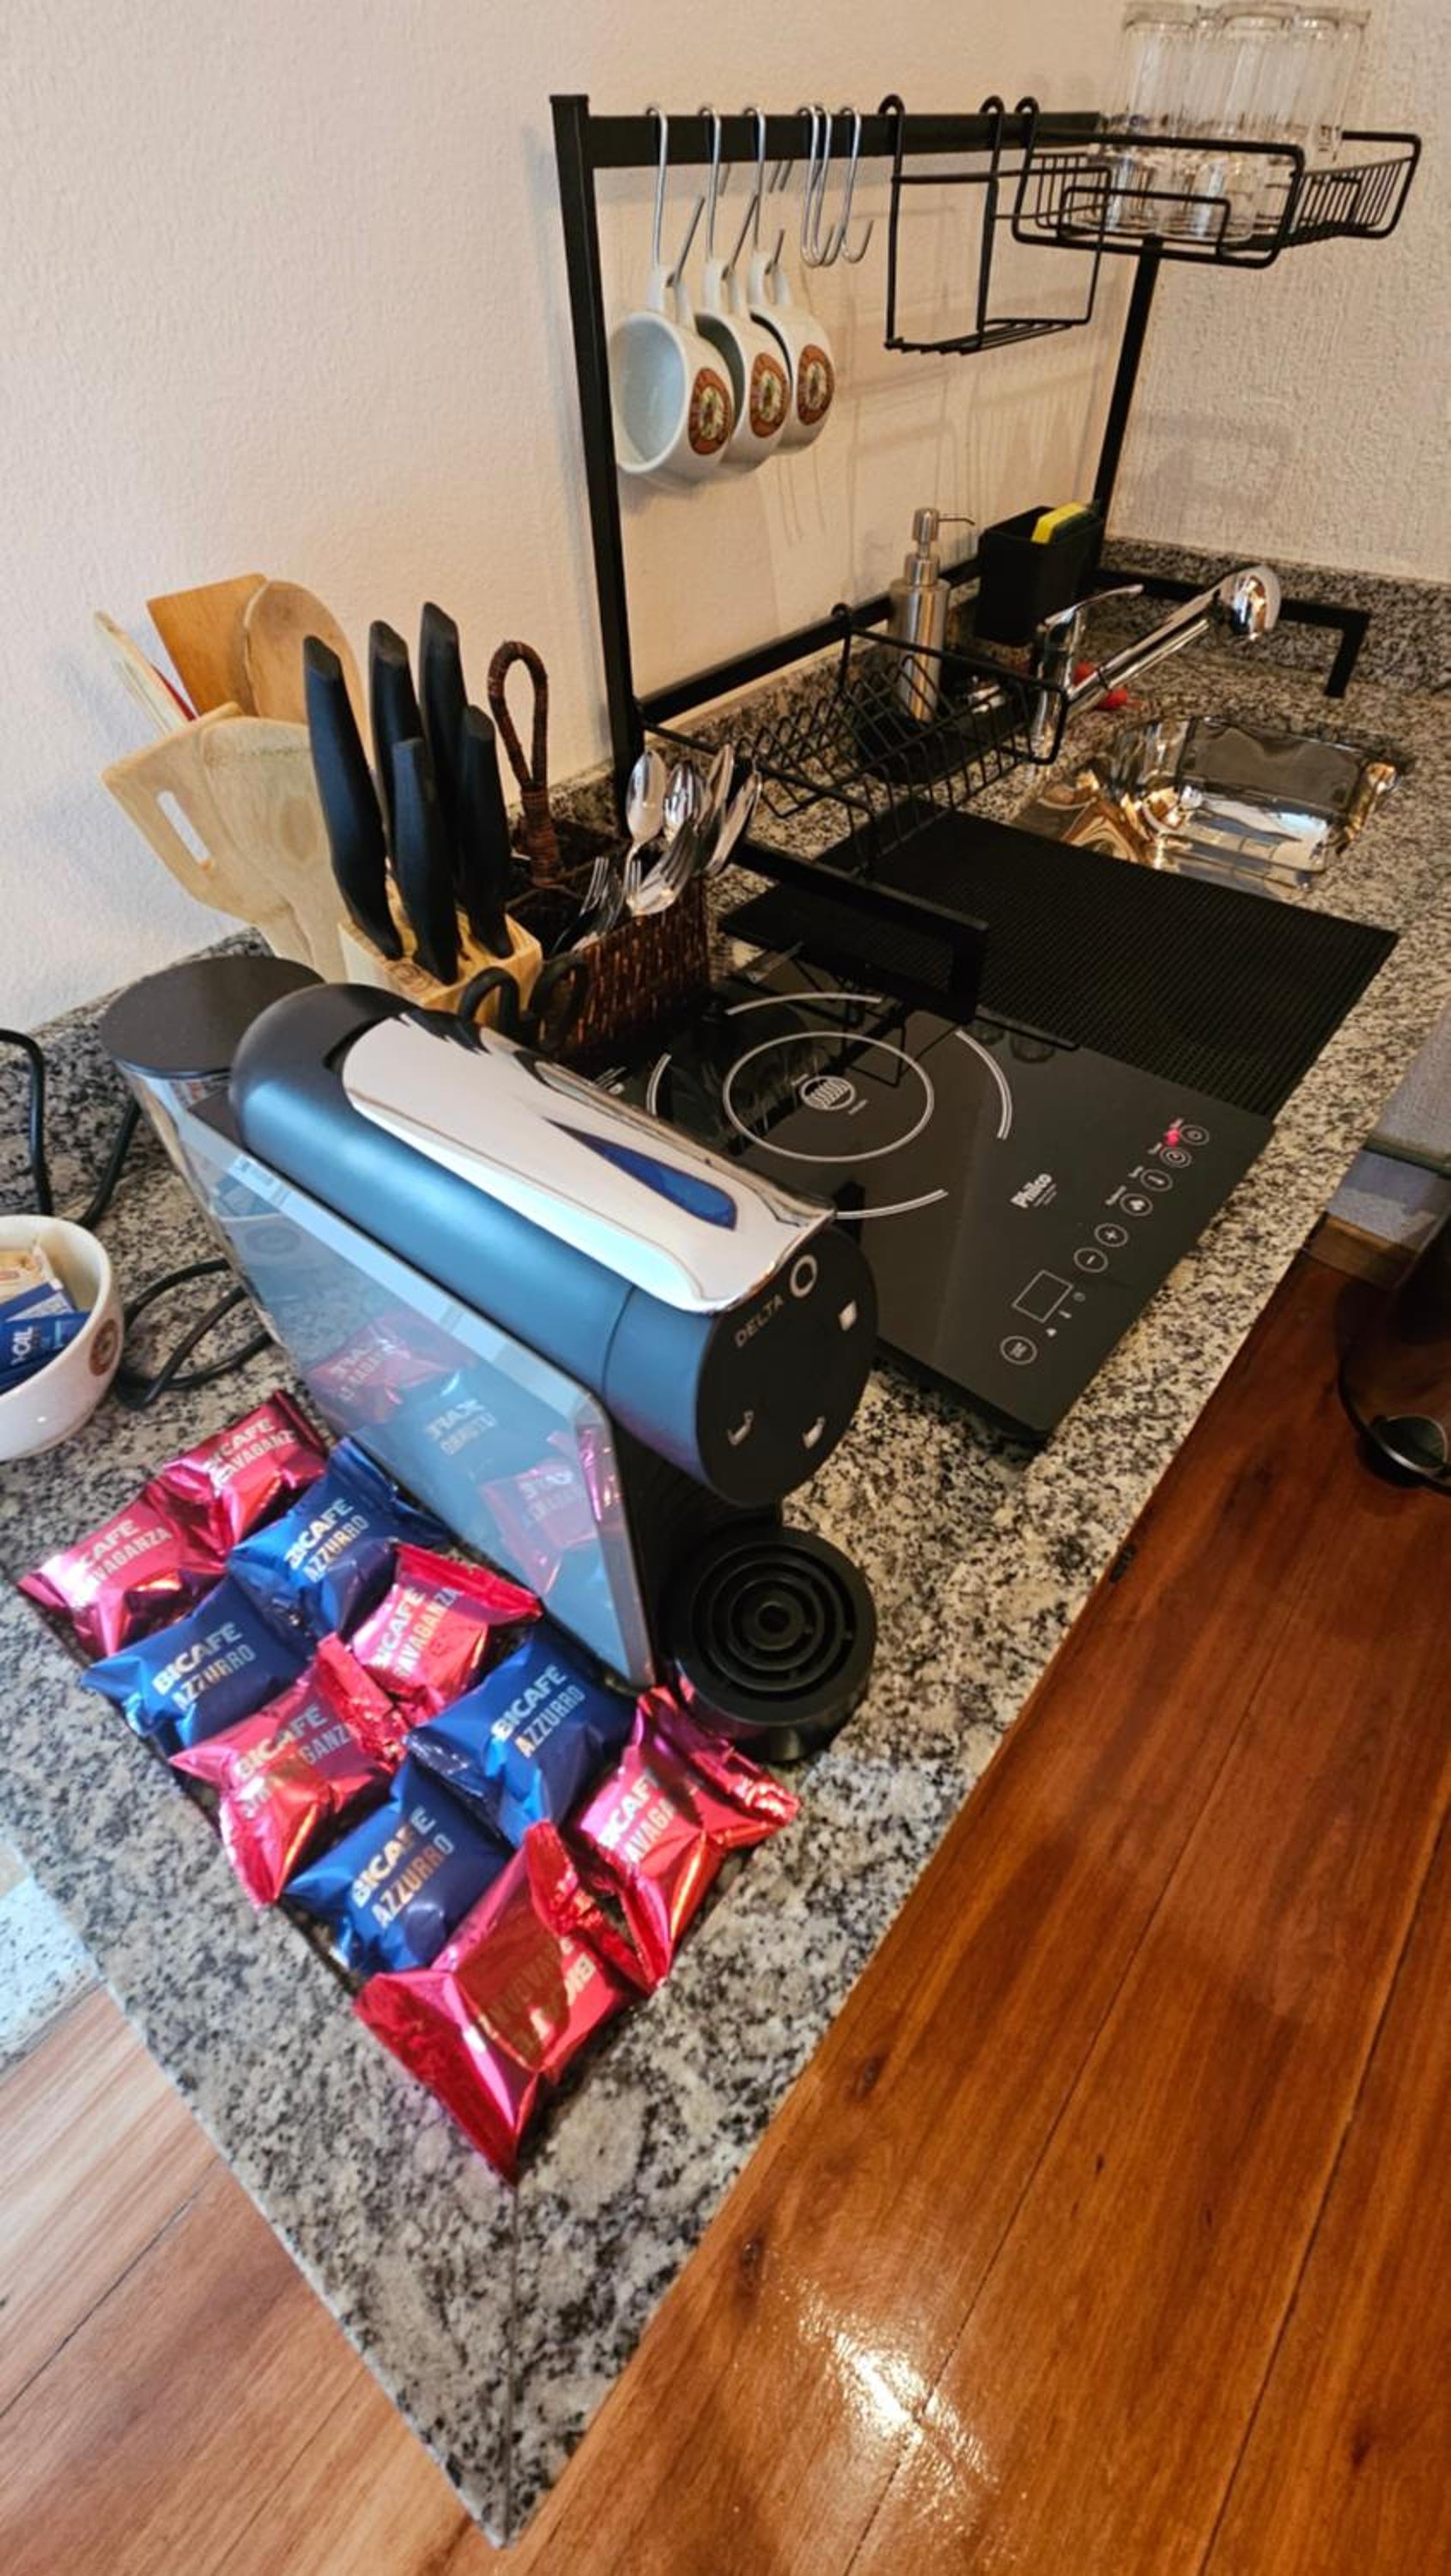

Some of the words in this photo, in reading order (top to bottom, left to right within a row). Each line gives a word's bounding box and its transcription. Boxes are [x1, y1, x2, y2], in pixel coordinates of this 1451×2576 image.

[1010, 1173, 1053, 1208] Philco
[734, 1294, 783, 1347] DELTA
[302, 1514, 370, 1584] AZZURRO
[151, 1620, 243, 1697] BICAFE
[173, 1643, 257, 1712] AZZURRO
[490, 1664, 568, 1743] BICAFE
[515, 1684, 586, 1759] AZZURRO
[351, 1806, 437, 1909] BICAFE
[372, 1833, 455, 1929] AZZURRO
